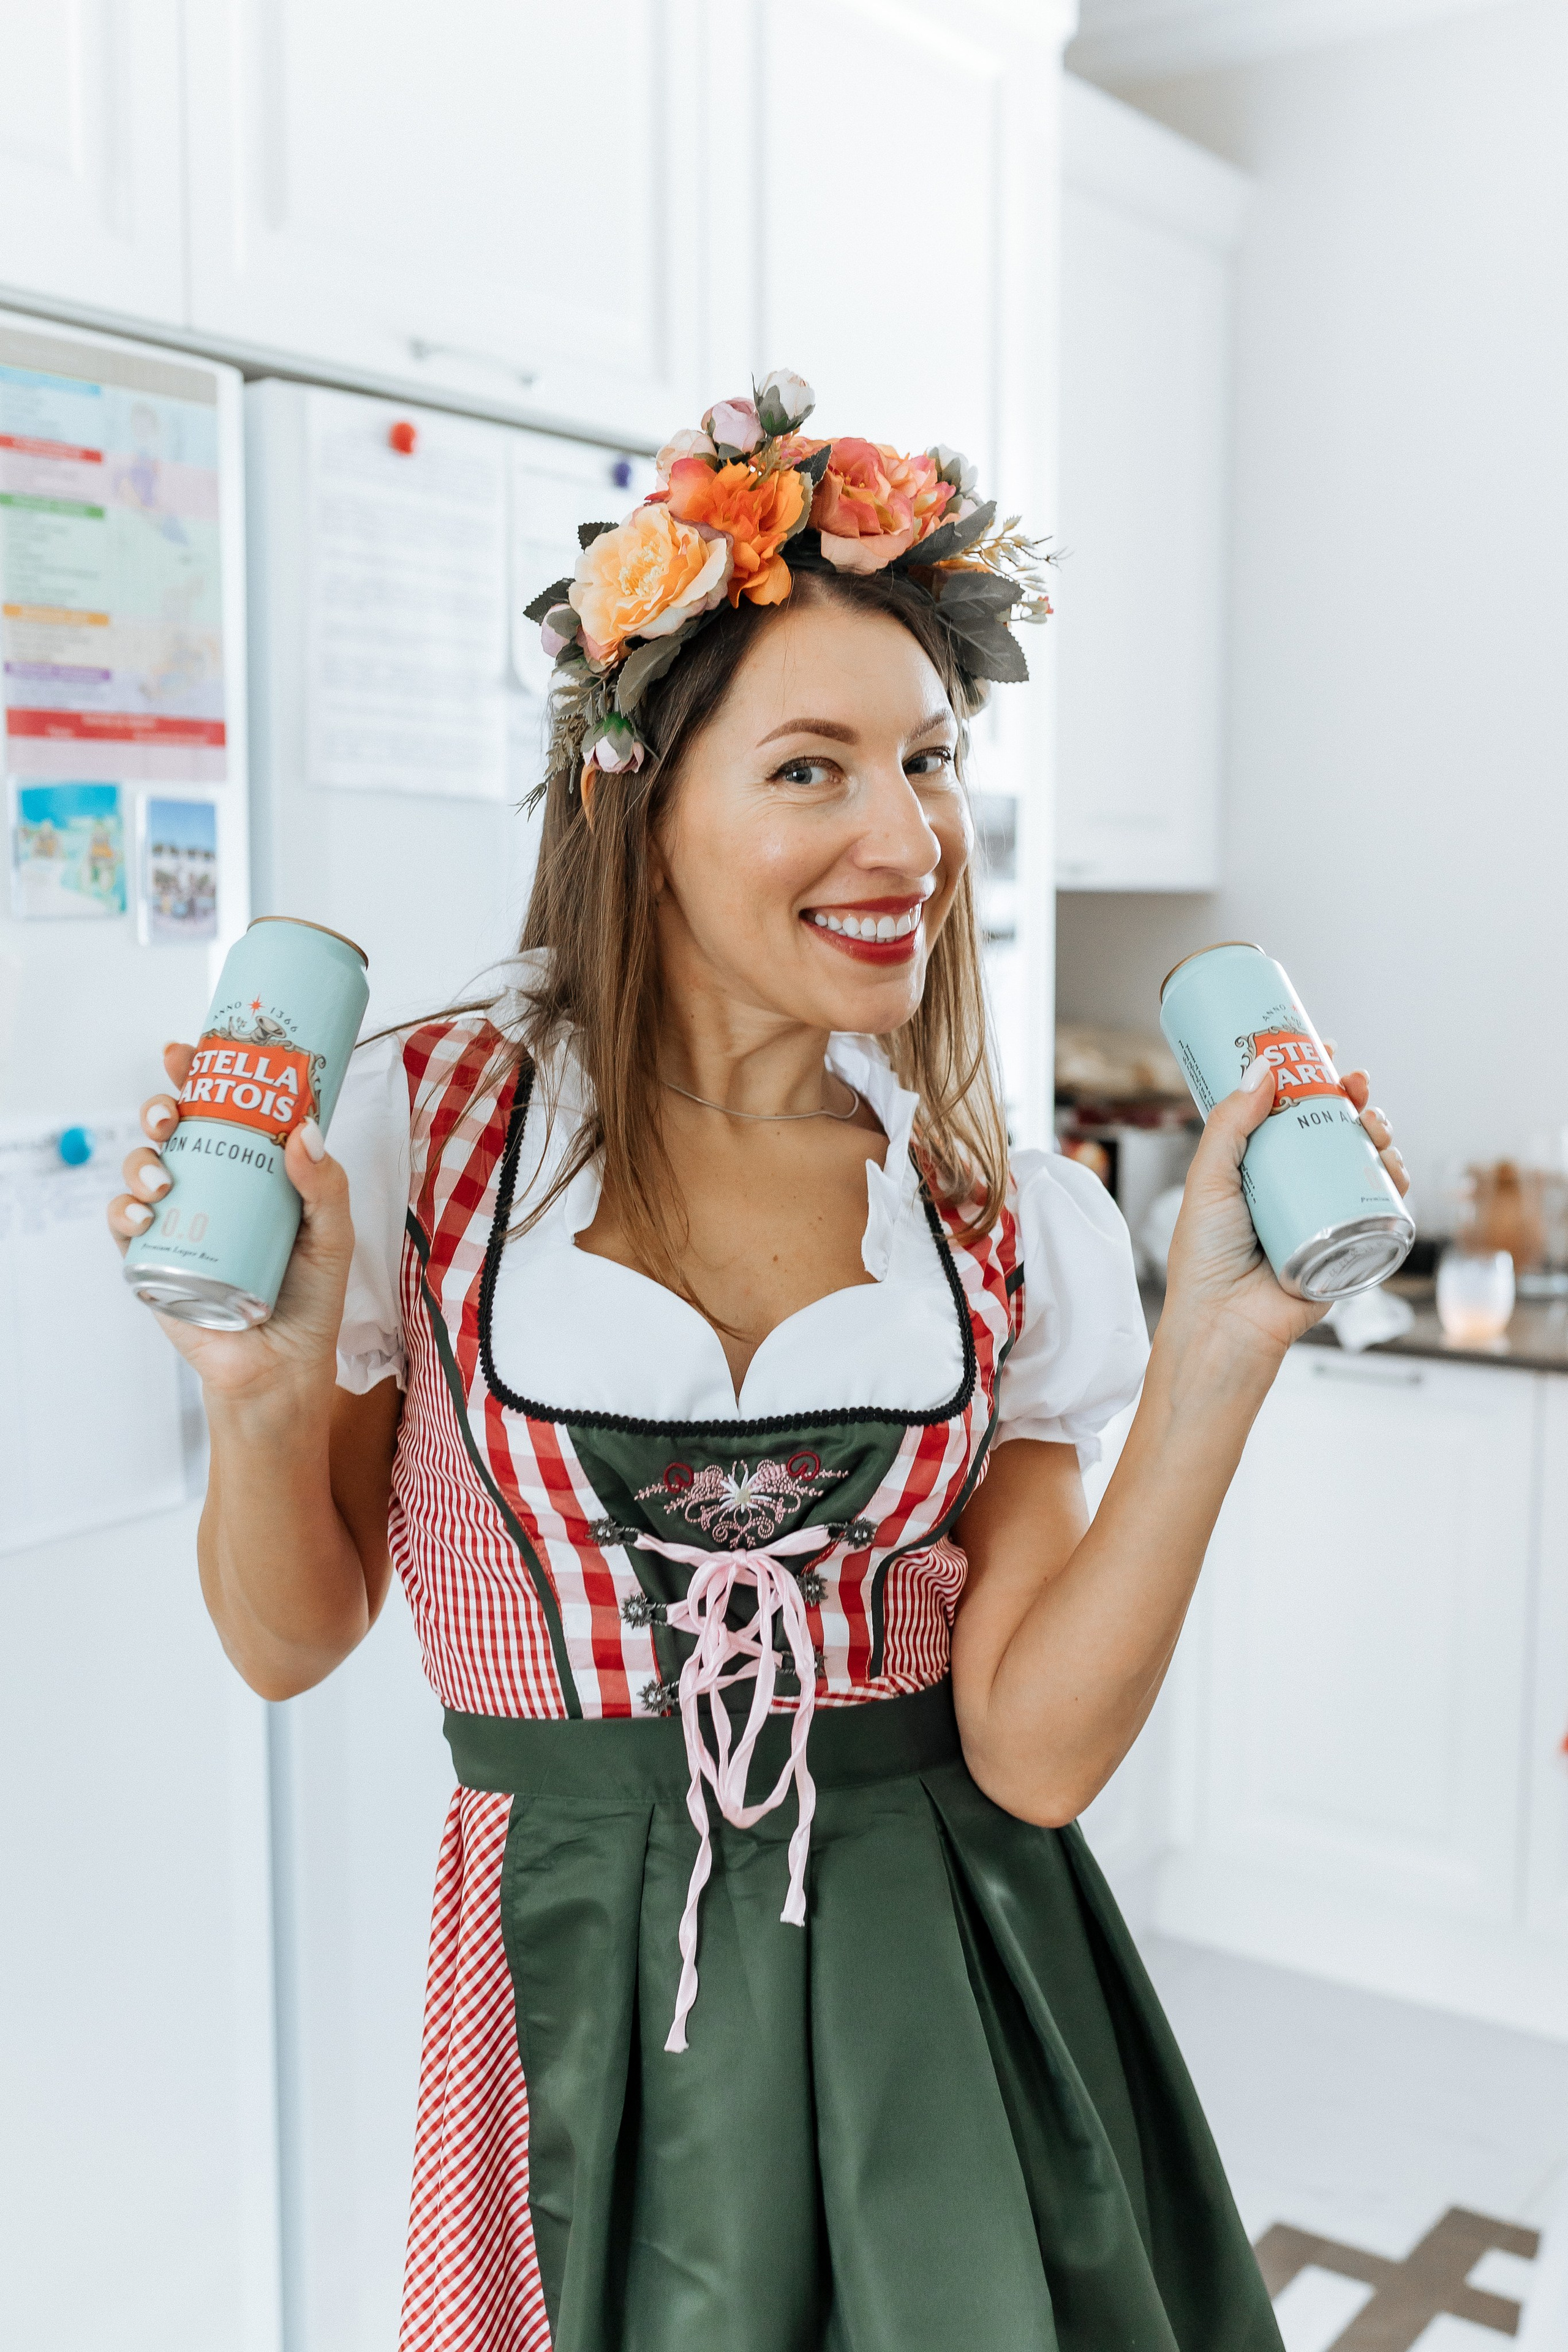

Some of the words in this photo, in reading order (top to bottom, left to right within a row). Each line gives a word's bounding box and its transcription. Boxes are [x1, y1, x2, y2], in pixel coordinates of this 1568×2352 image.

[270, 1007, 298, 1032] 1366
[1262, 1004, 1286, 1022] ANNO
[188, 1049, 300, 1096] STELLA
[1276, 1063, 1339, 1091] ART
[178, 1077, 295, 1123] ARTOIS
[1297, 1110, 1333, 1129] NON
[191, 1137, 274, 1174] ALCOHOL
[161, 1207, 209, 1243] 0.0
